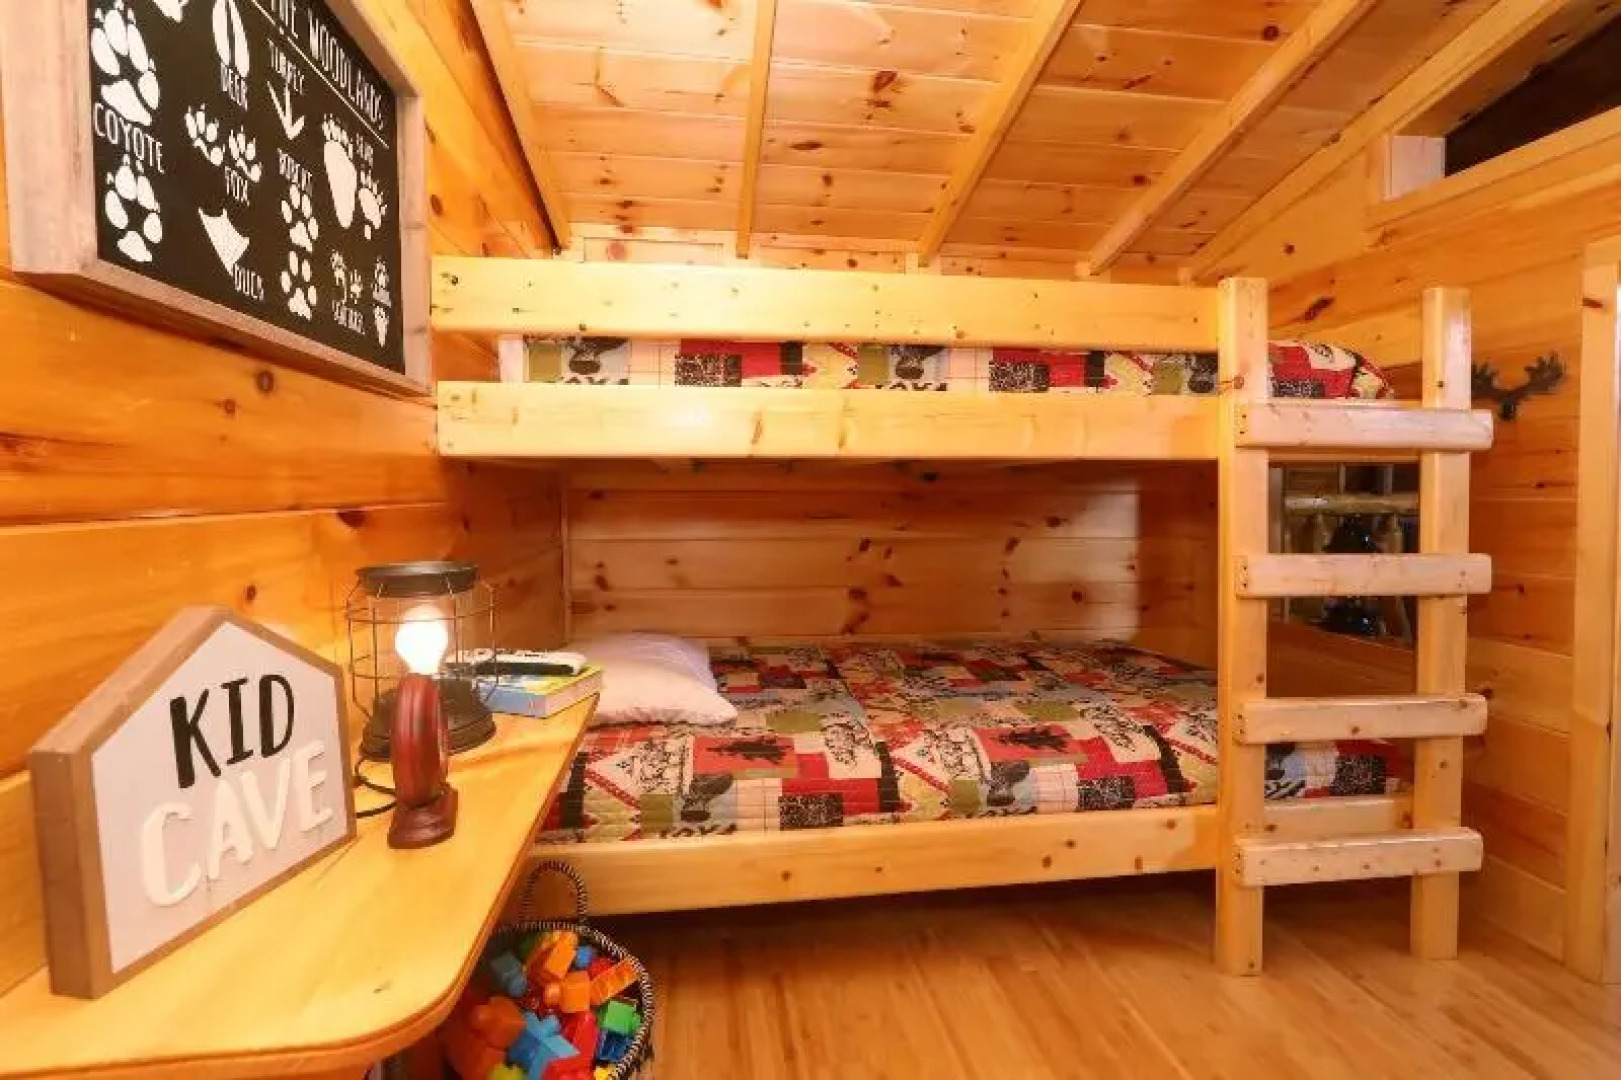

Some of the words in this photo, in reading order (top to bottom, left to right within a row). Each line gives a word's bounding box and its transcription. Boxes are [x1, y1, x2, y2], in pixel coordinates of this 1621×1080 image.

[270, 0, 299, 39] HE
[307, 7, 383, 131] WOODLANDS
[93, 102, 164, 174] COYOTE
[224, 165, 250, 207] FOX
[170, 674, 295, 789] KID
[142, 740, 334, 906] CAVE
